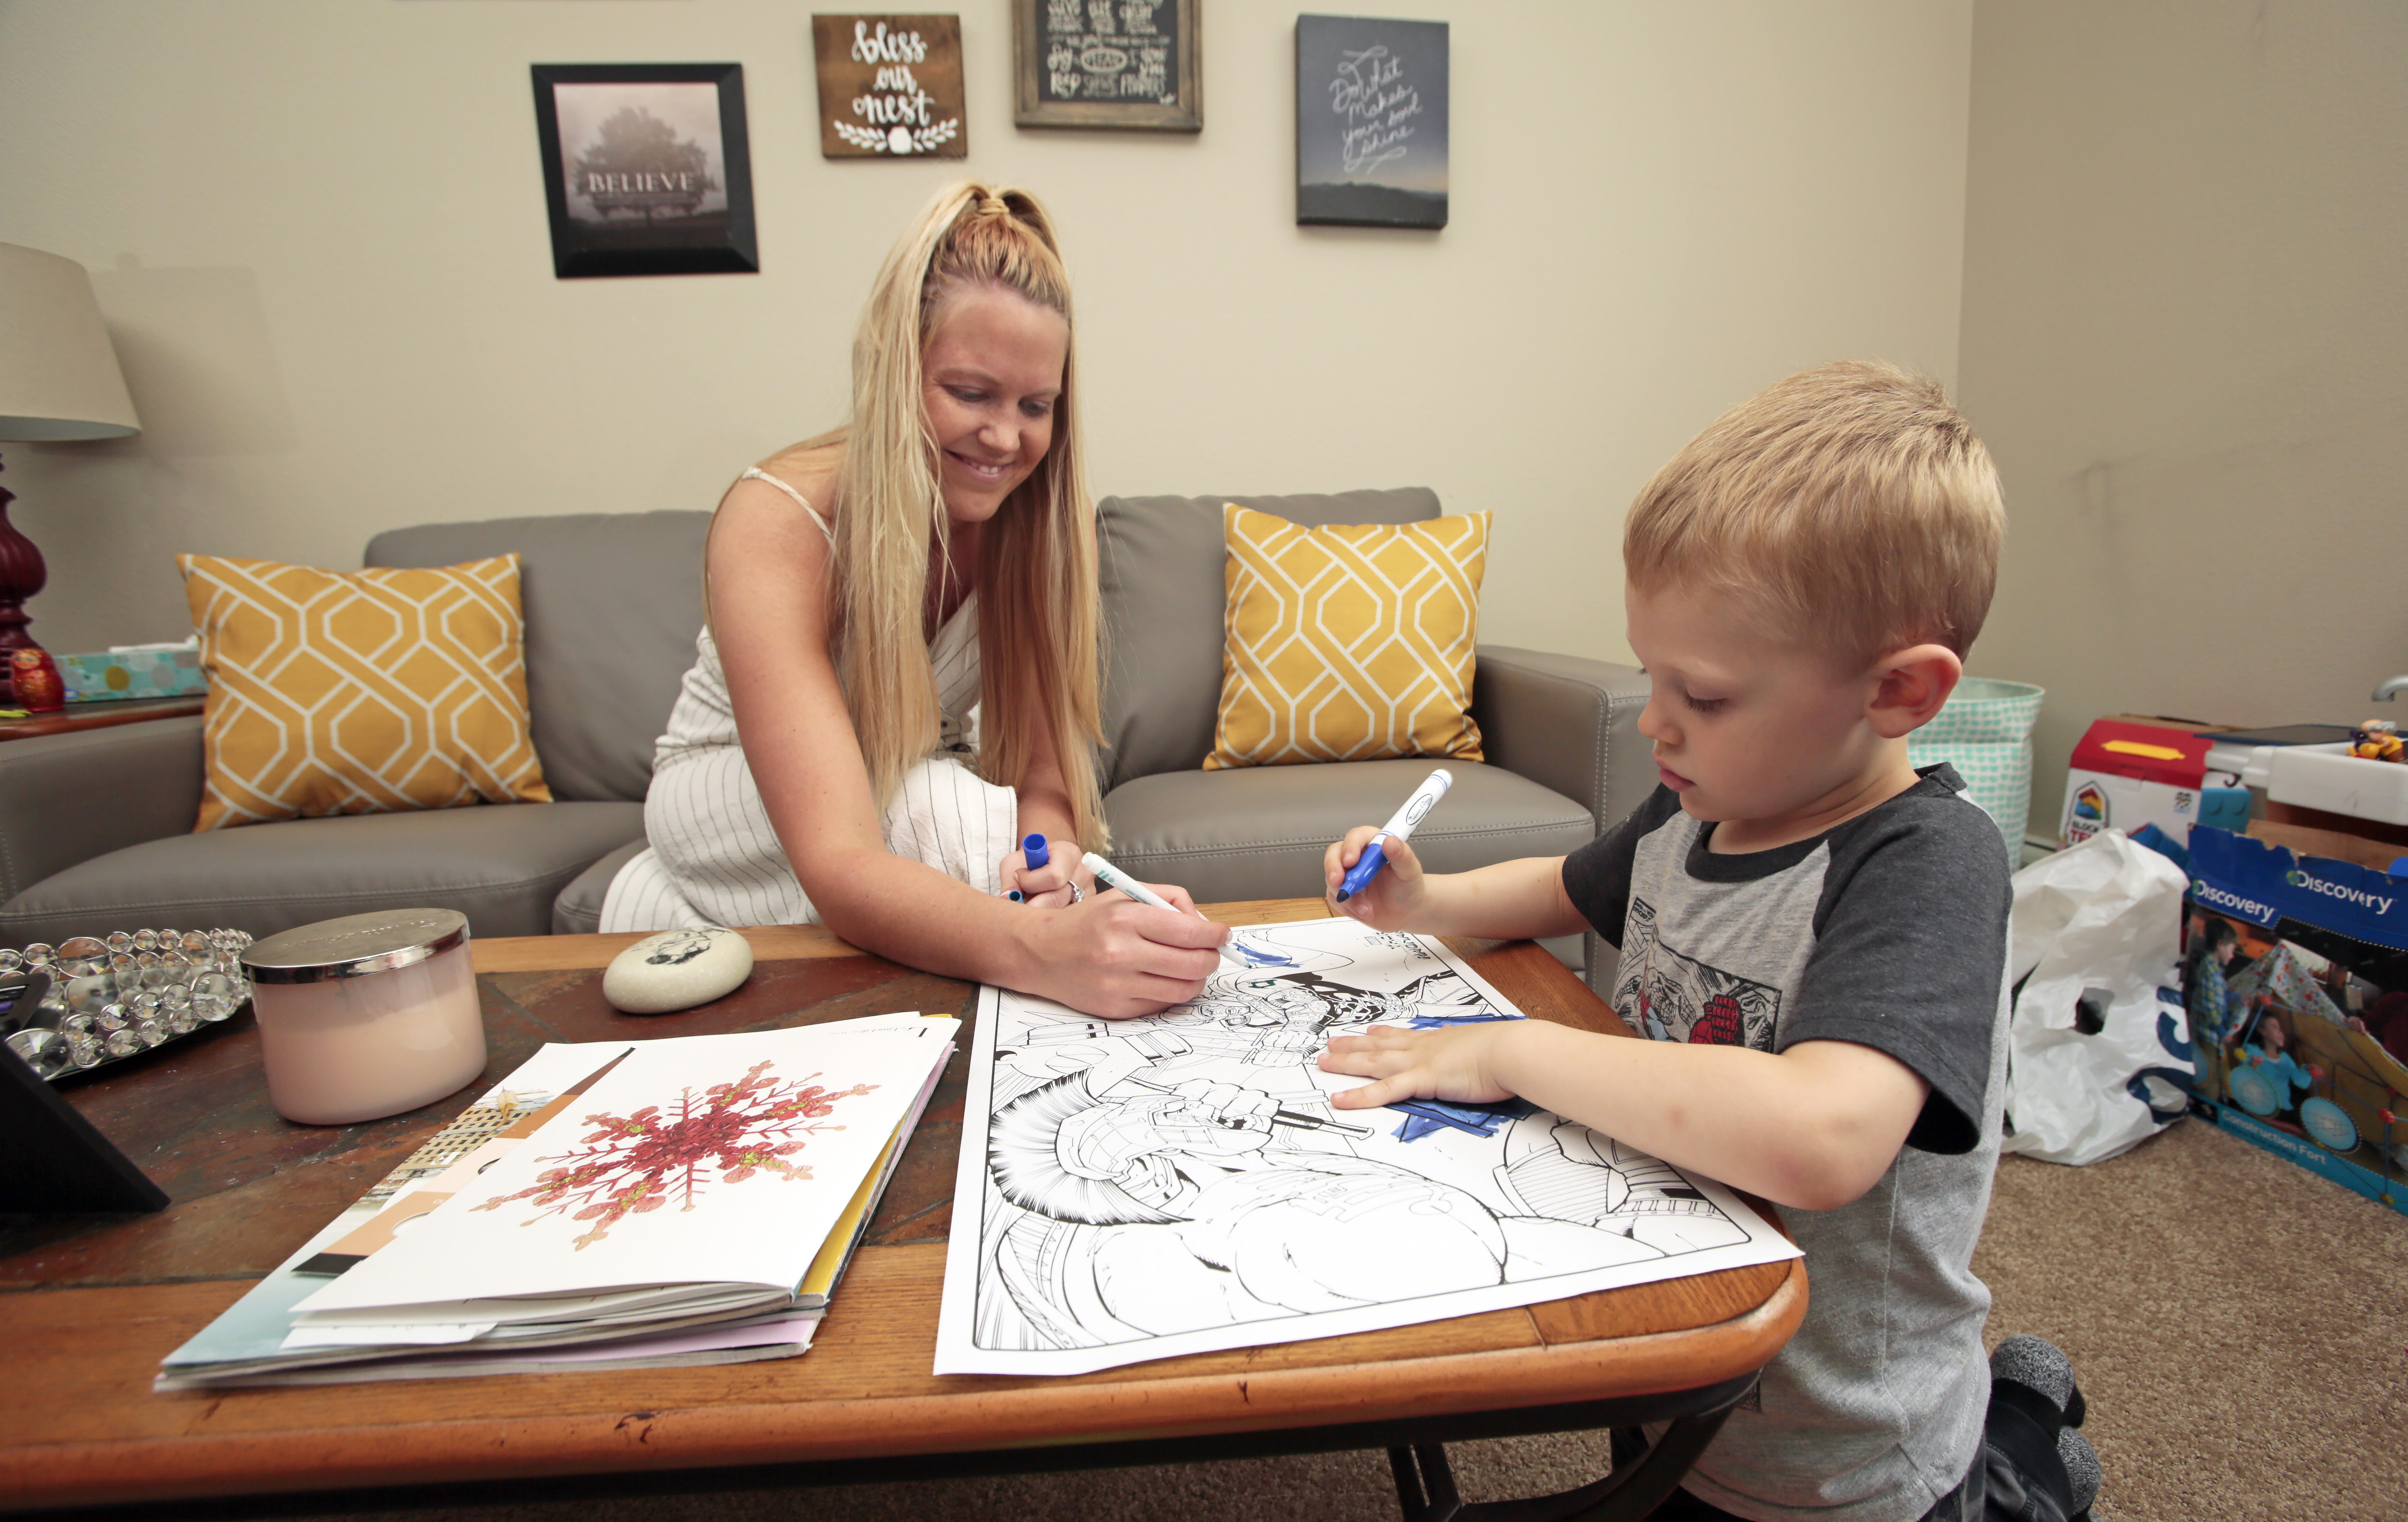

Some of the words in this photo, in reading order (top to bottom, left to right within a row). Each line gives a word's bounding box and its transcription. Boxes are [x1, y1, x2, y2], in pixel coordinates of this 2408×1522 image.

[852, 20, 928, 65] bless
[873, 65, 918, 95] our
[852, 88, 935, 127] nest
[589, 172, 695, 193] BELIEVE
[2073, 821, 2099, 833] BLOCK
[2196, 880, 2275, 923] Discovery
[2295, 870, 2394, 915] Discovery
[2221, 1110, 2297, 1152] Construction
[2299, 1144, 2327, 1165] Fort
